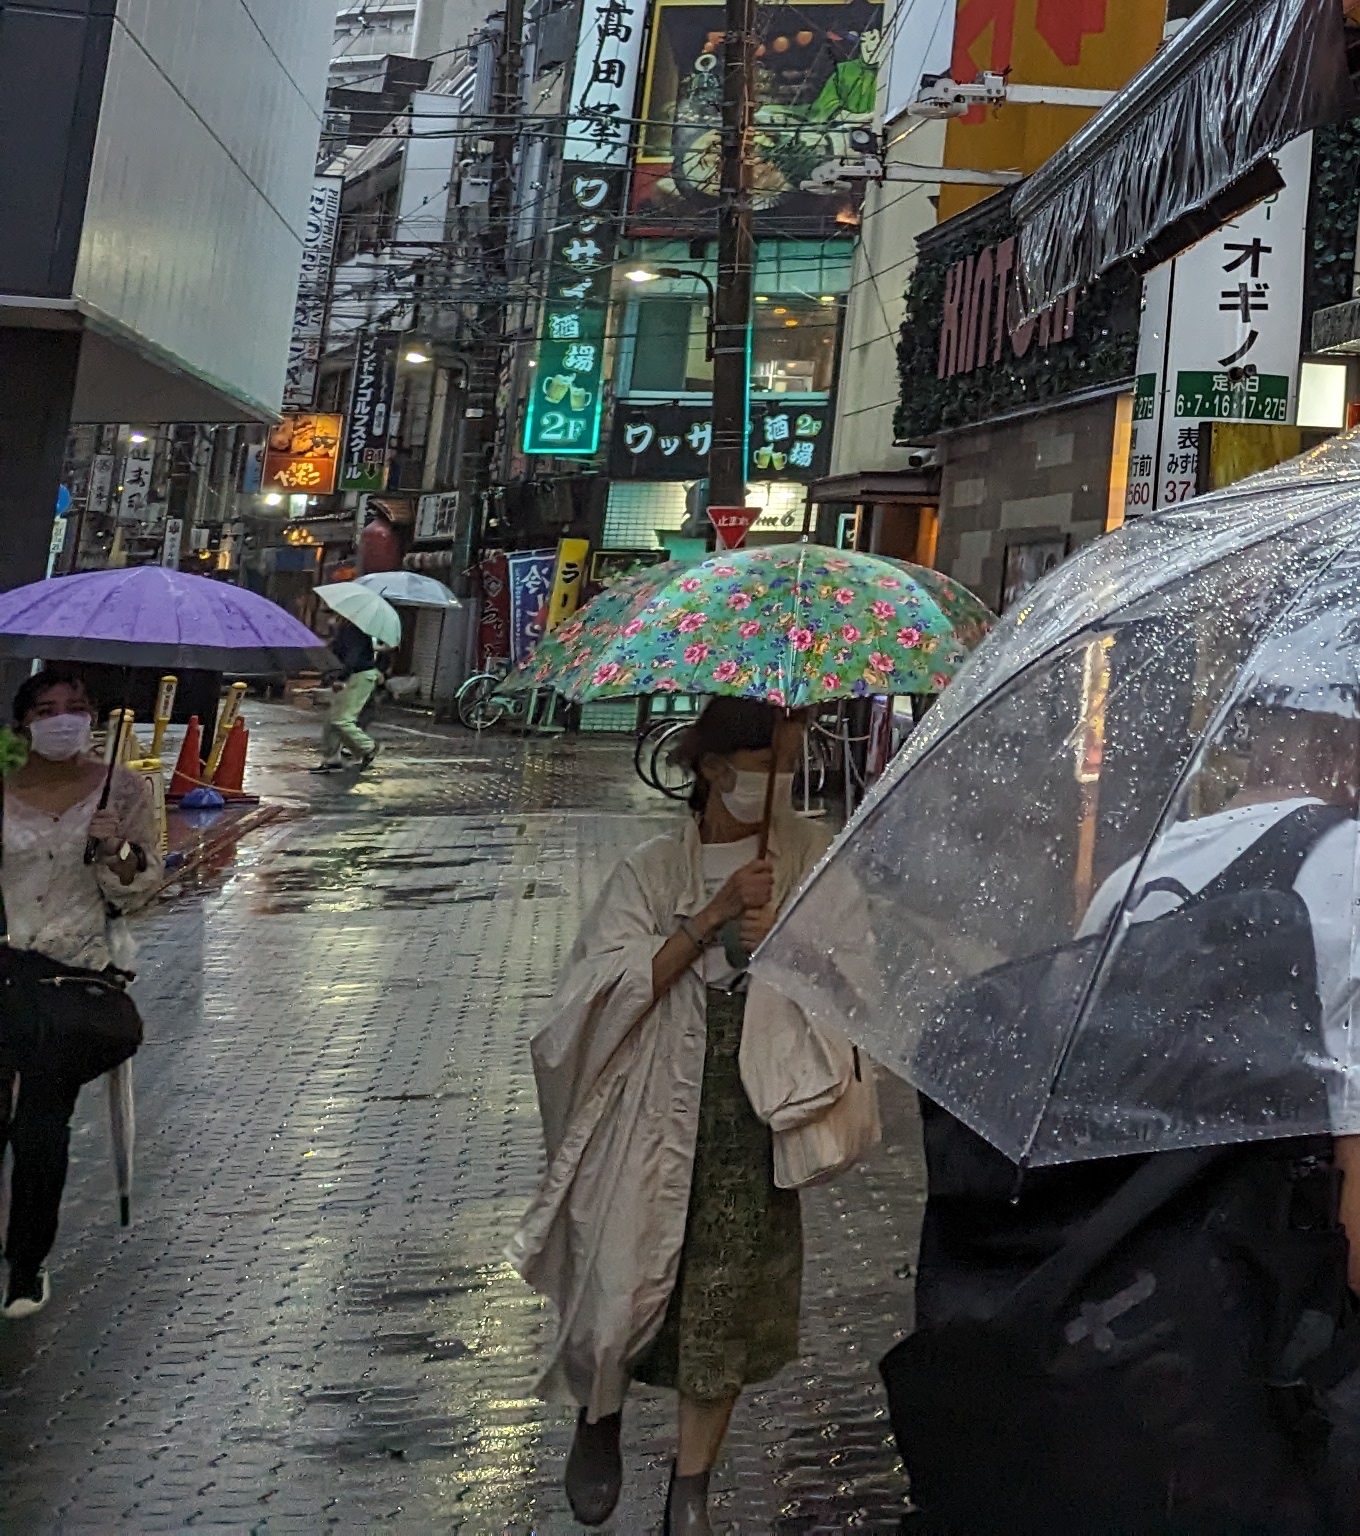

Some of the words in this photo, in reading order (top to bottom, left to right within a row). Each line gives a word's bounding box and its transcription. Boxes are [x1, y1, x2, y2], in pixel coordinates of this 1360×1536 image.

[1217, 238, 1272, 367] オギノ
[539, 411, 587, 442] 2F
